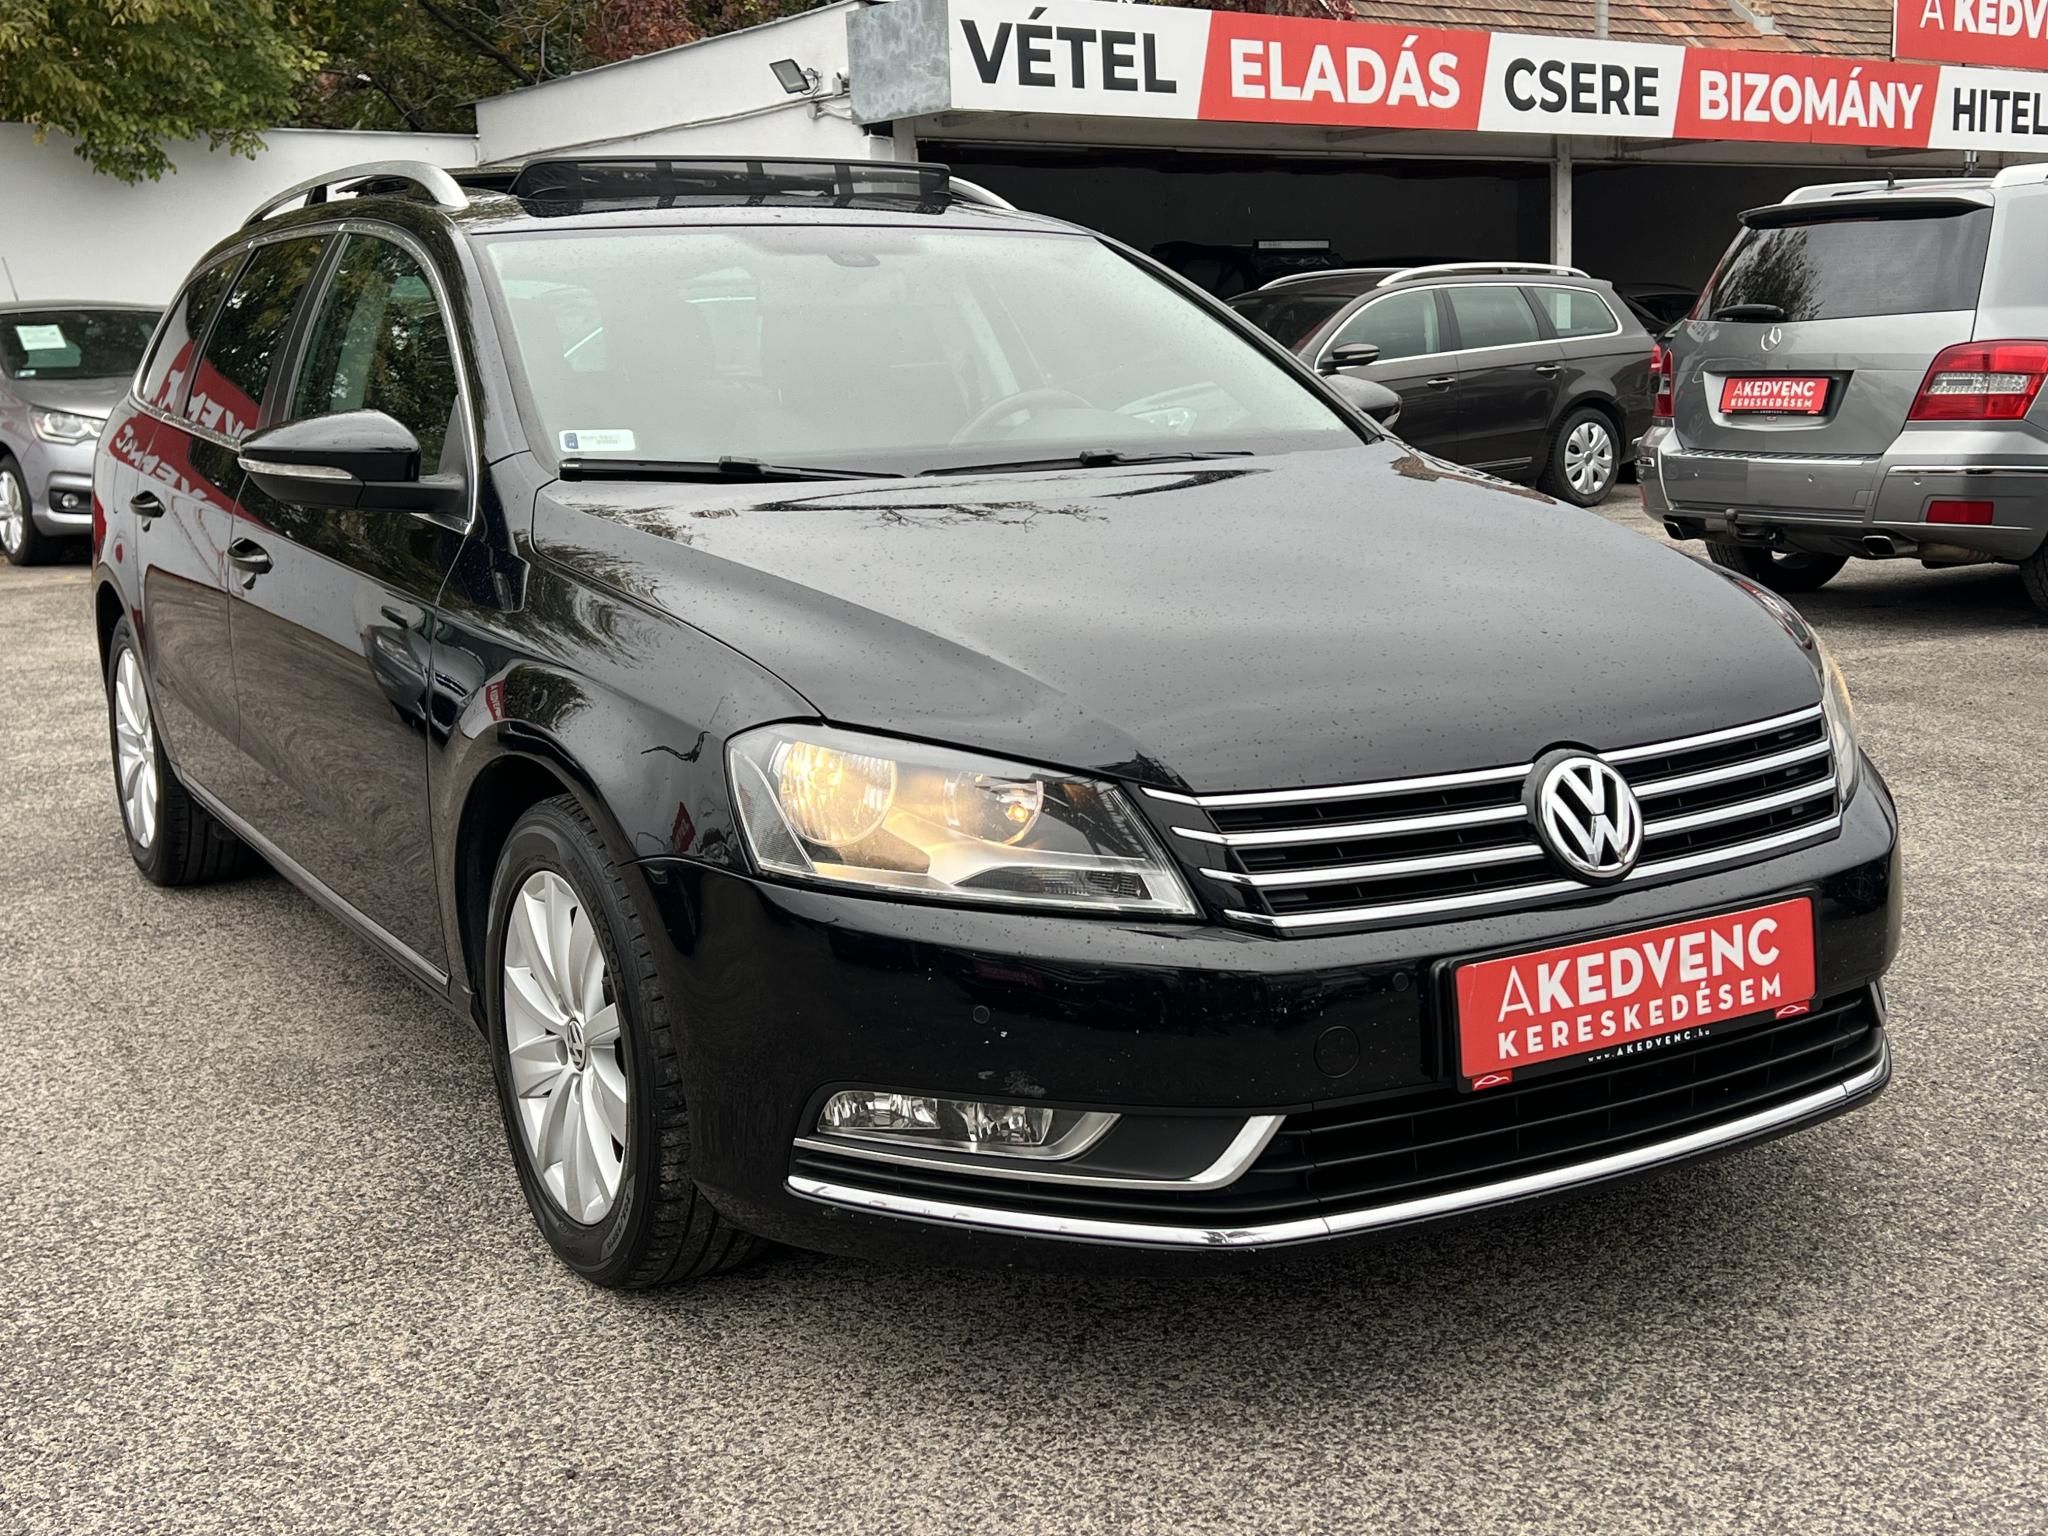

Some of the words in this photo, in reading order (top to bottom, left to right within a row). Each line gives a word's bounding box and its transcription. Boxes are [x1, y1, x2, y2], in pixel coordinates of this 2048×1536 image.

[1919, 0, 1945, 30] A
[1953, 0, 2048, 39] KEDV
[959, 7, 1178, 94] VÉTEL
[1229, 34, 1461, 109] ELADÁS
[1503, 57, 1660, 117] CSERE
[1699, 66, 1924, 130] BIZOMÁNY
[1952, 87, 2048, 135] HITEL
[1730, 397, 1812, 408] KERESKEDÉSEM
[1498, 972, 1782, 1060] KERESKEDÉSEM
